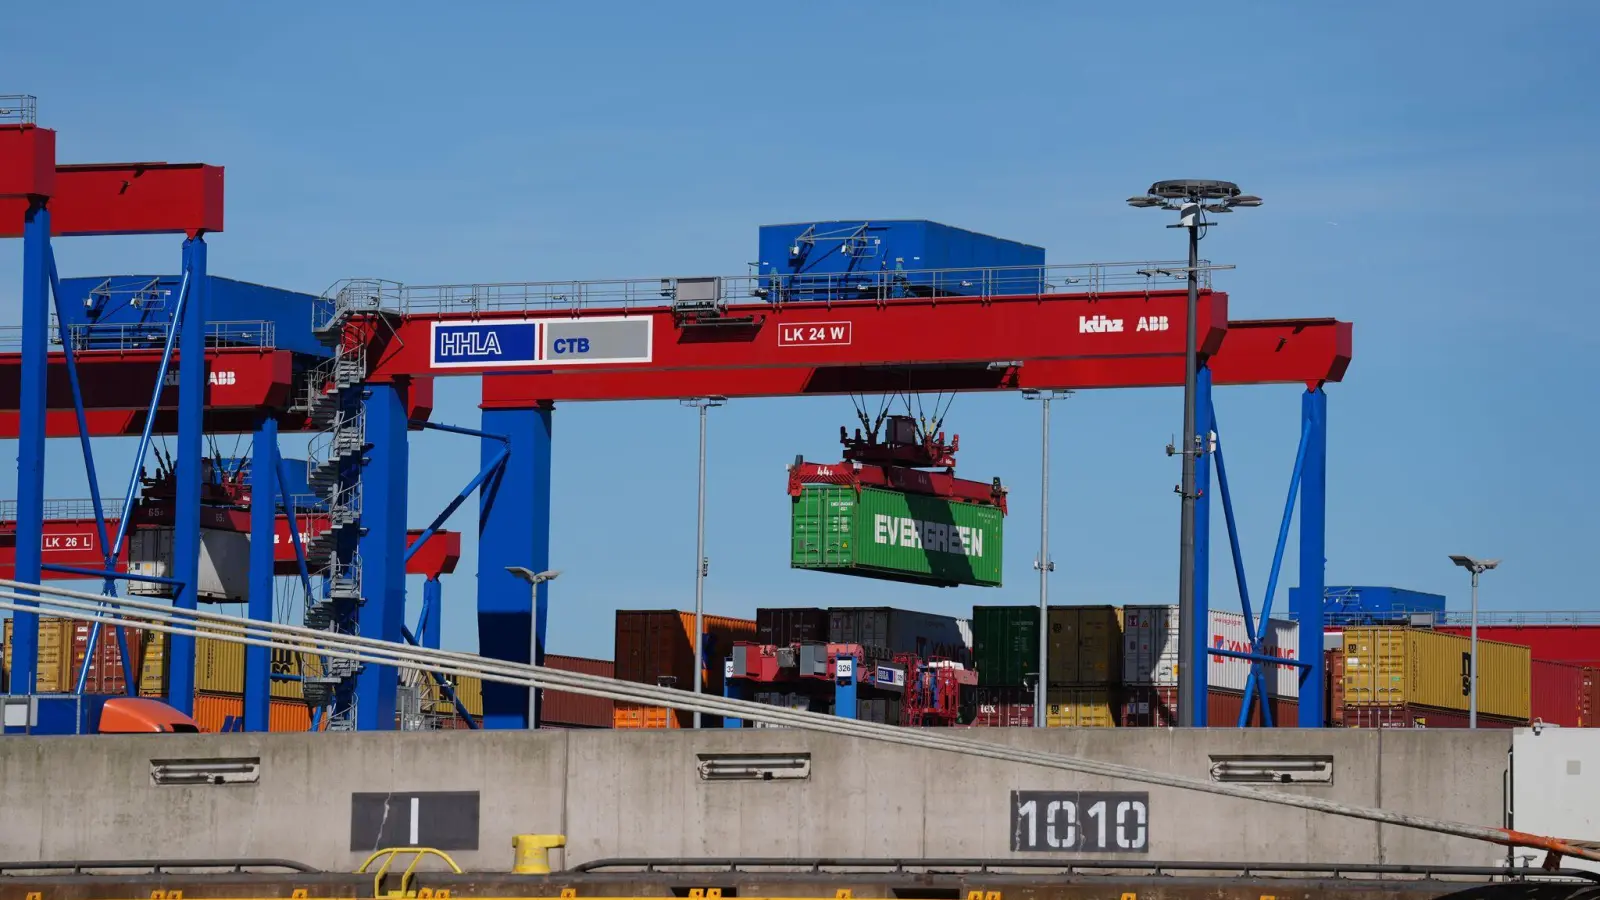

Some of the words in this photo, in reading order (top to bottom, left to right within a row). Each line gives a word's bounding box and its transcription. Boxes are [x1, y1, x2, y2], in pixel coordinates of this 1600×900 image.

[1136, 316, 1169, 332] ABB
[784, 328, 804, 341] LK
[809, 327, 825, 341] 24
[830, 326, 845, 340] W
[441, 331, 502, 356] HHLA
[554, 338, 590, 353] CTB
[207, 371, 236, 386] ABB
[45, 537, 60, 548] LK
[65, 537, 77, 547] 26
[83, 537, 91, 547] L
[874, 513, 983, 557] EVERGREEN
[838, 665, 851, 673] 326
